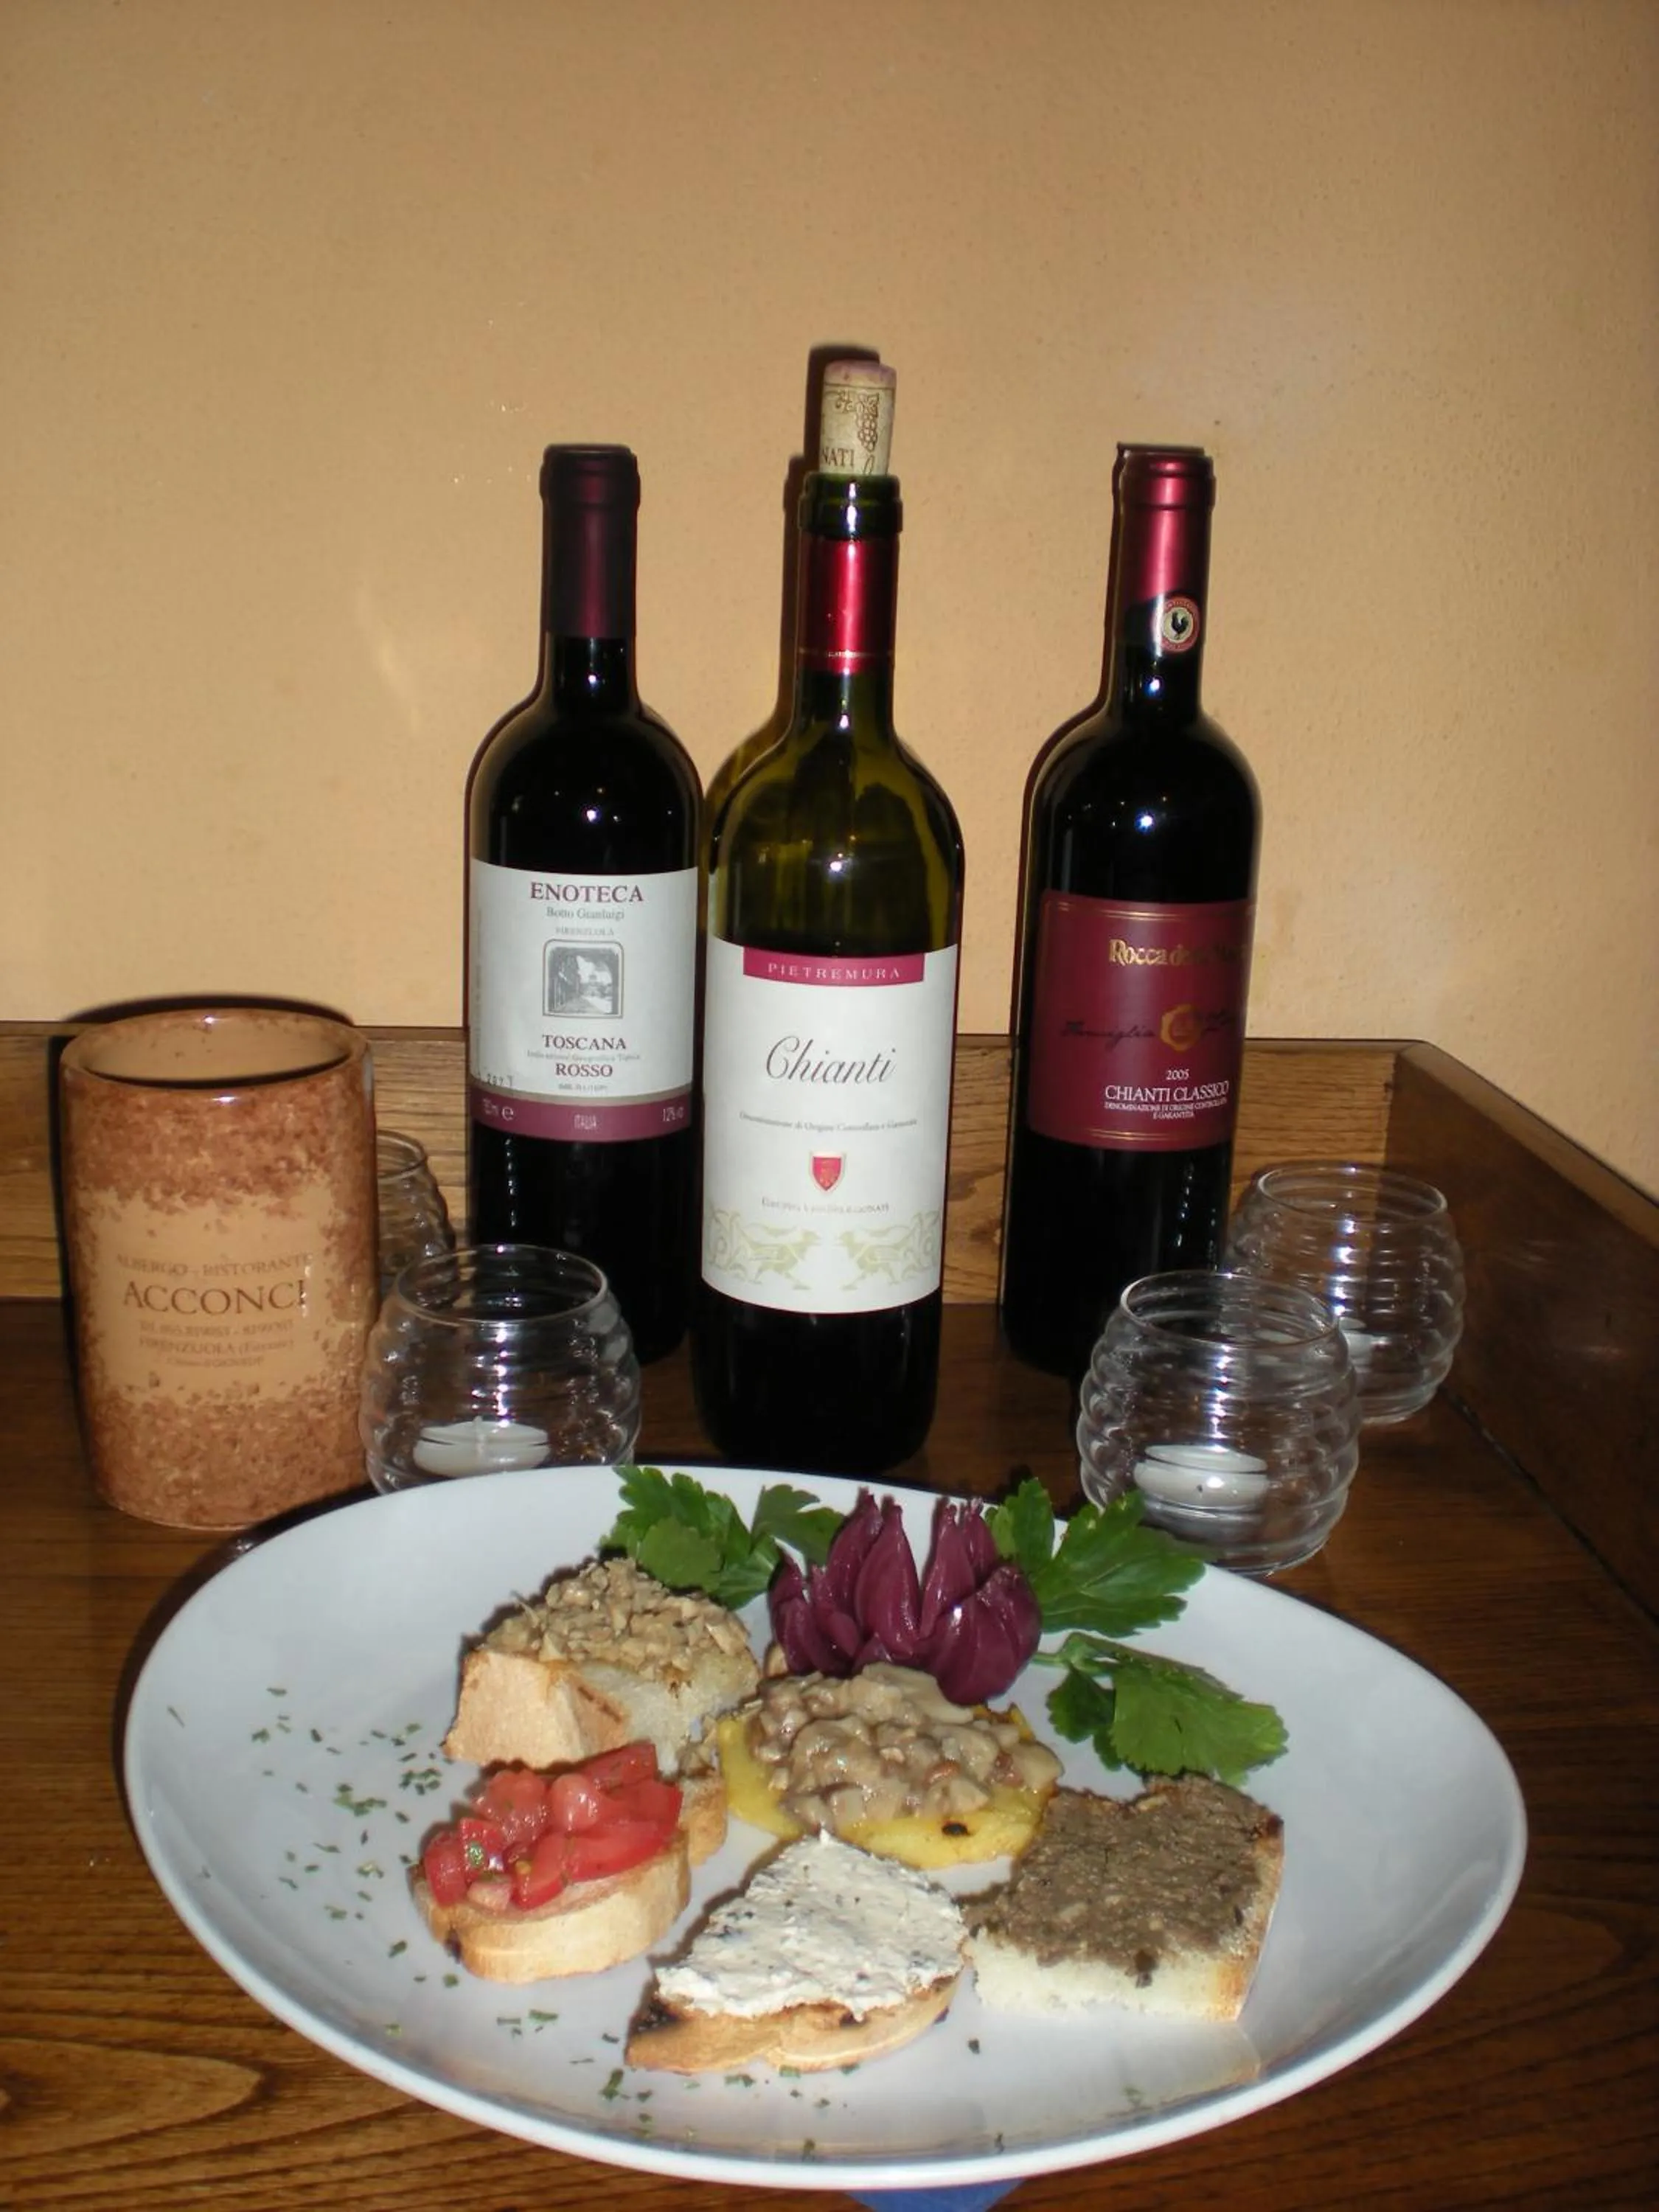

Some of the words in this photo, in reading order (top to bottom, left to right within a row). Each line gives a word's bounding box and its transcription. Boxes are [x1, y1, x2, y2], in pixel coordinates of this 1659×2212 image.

[529, 881, 644, 904] ENOTECA
[1109, 938, 1169, 966] Rocca
[768, 962, 902, 981] PIETREMURA
[541, 1034, 627, 1051] TOSCANA
[555, 1062, 613, 1077] ROSSO
[765, 1035, 897, 1085] Chianti
[1105, 1085, 1170, 1102] CHIANTI
[1173, 1080, 1230, 1102] CLASSICO
[122, 1279, 307, 1315] ACCONCI
